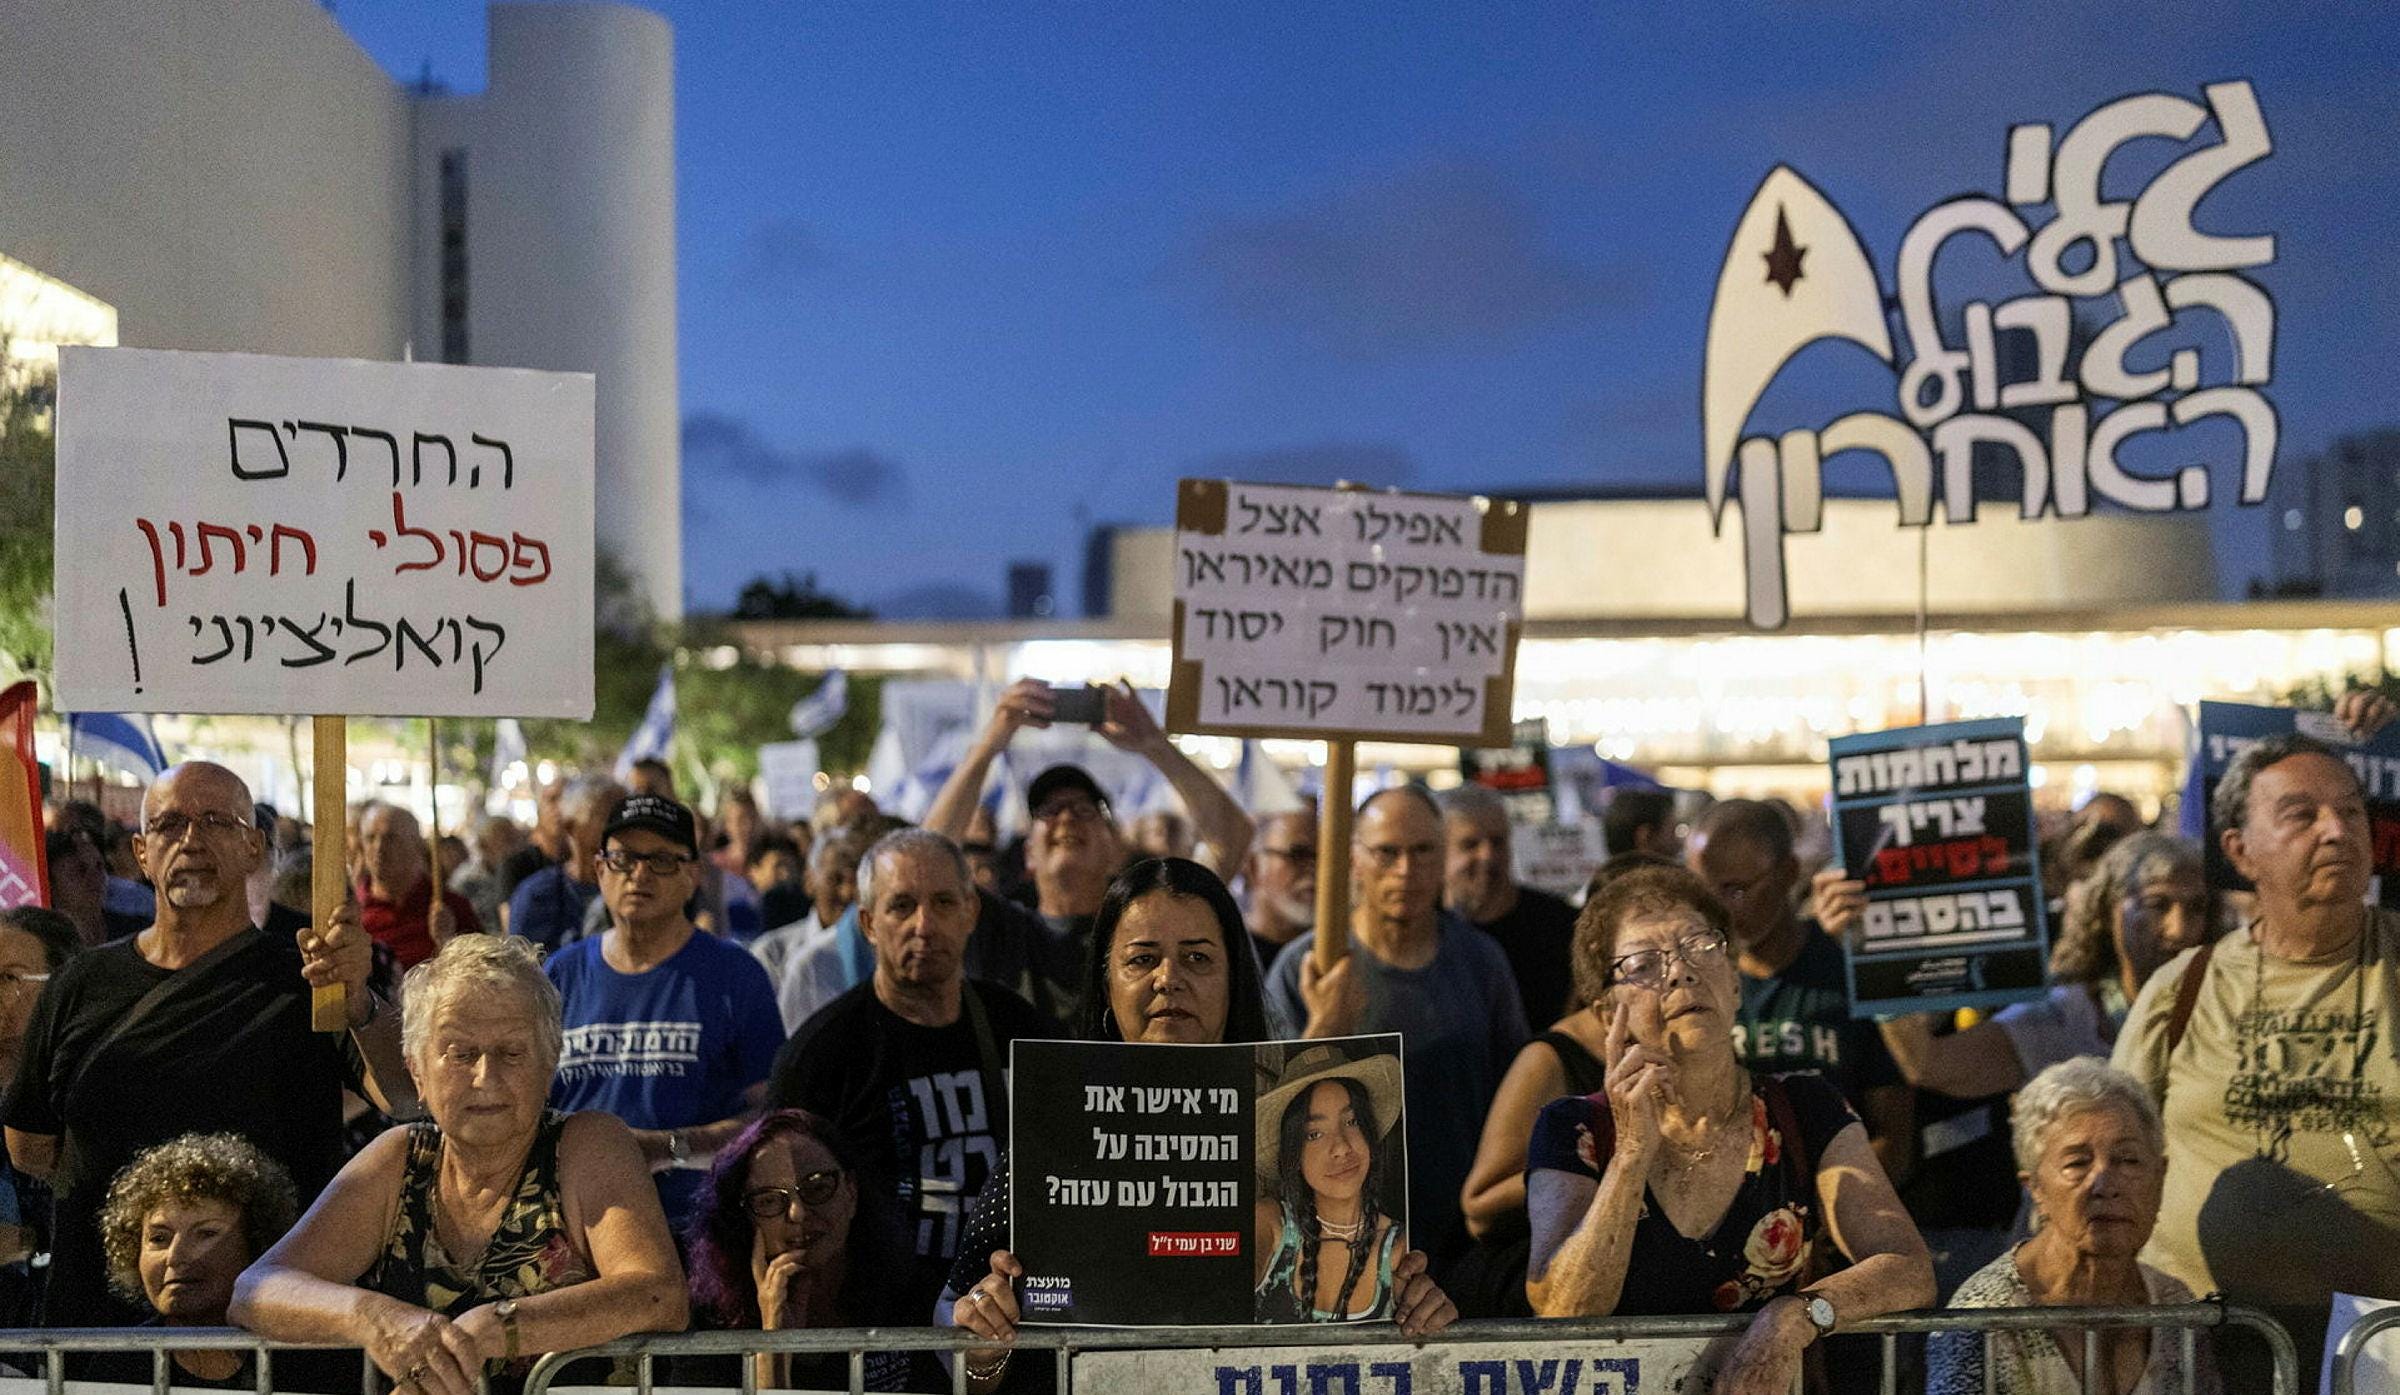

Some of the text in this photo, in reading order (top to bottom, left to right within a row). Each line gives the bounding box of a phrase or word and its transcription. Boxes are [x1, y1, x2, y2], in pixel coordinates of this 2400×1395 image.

[1897, 192, 2276, 430] הגבול
[228, 417, 514, 490] החרדים
[1238, 493, 1463, 546] אפילו אצל
[1737, 385, 2279, 631] האחרון
[136, 491, 552, 608] פסולי חיתון
[1181, 547, 1519, 602] הדפוקים מאיראן
[119, 577, 507, 695] קואליציוני !
[1194, 606, 1498, 661] אין חוק יסוד
[1215, 674, 1478, 720] לימוד קוראן
[1837, 739, 2021, 796] מלחמות
[1878, 797, 1987, 848] צריך
[1863, 888, 2025, 939] בהסכם
[1084, 1085, 1239, 1115] מי אישר את
[1093, 1126, 1239, 1161] המסיבה על
[1046, 1175, 1239, 1208] הגבול עם עזה?
[1175, 1236, 1198, 1251] עמי
[1200, 1237, 1213, 1253] בן
[1215, 1237, 1237, 1251] שני
[1026, 1276, 1071, 1289] מועצת
[1027, 1292, 1069, 1305] אוקטובר
